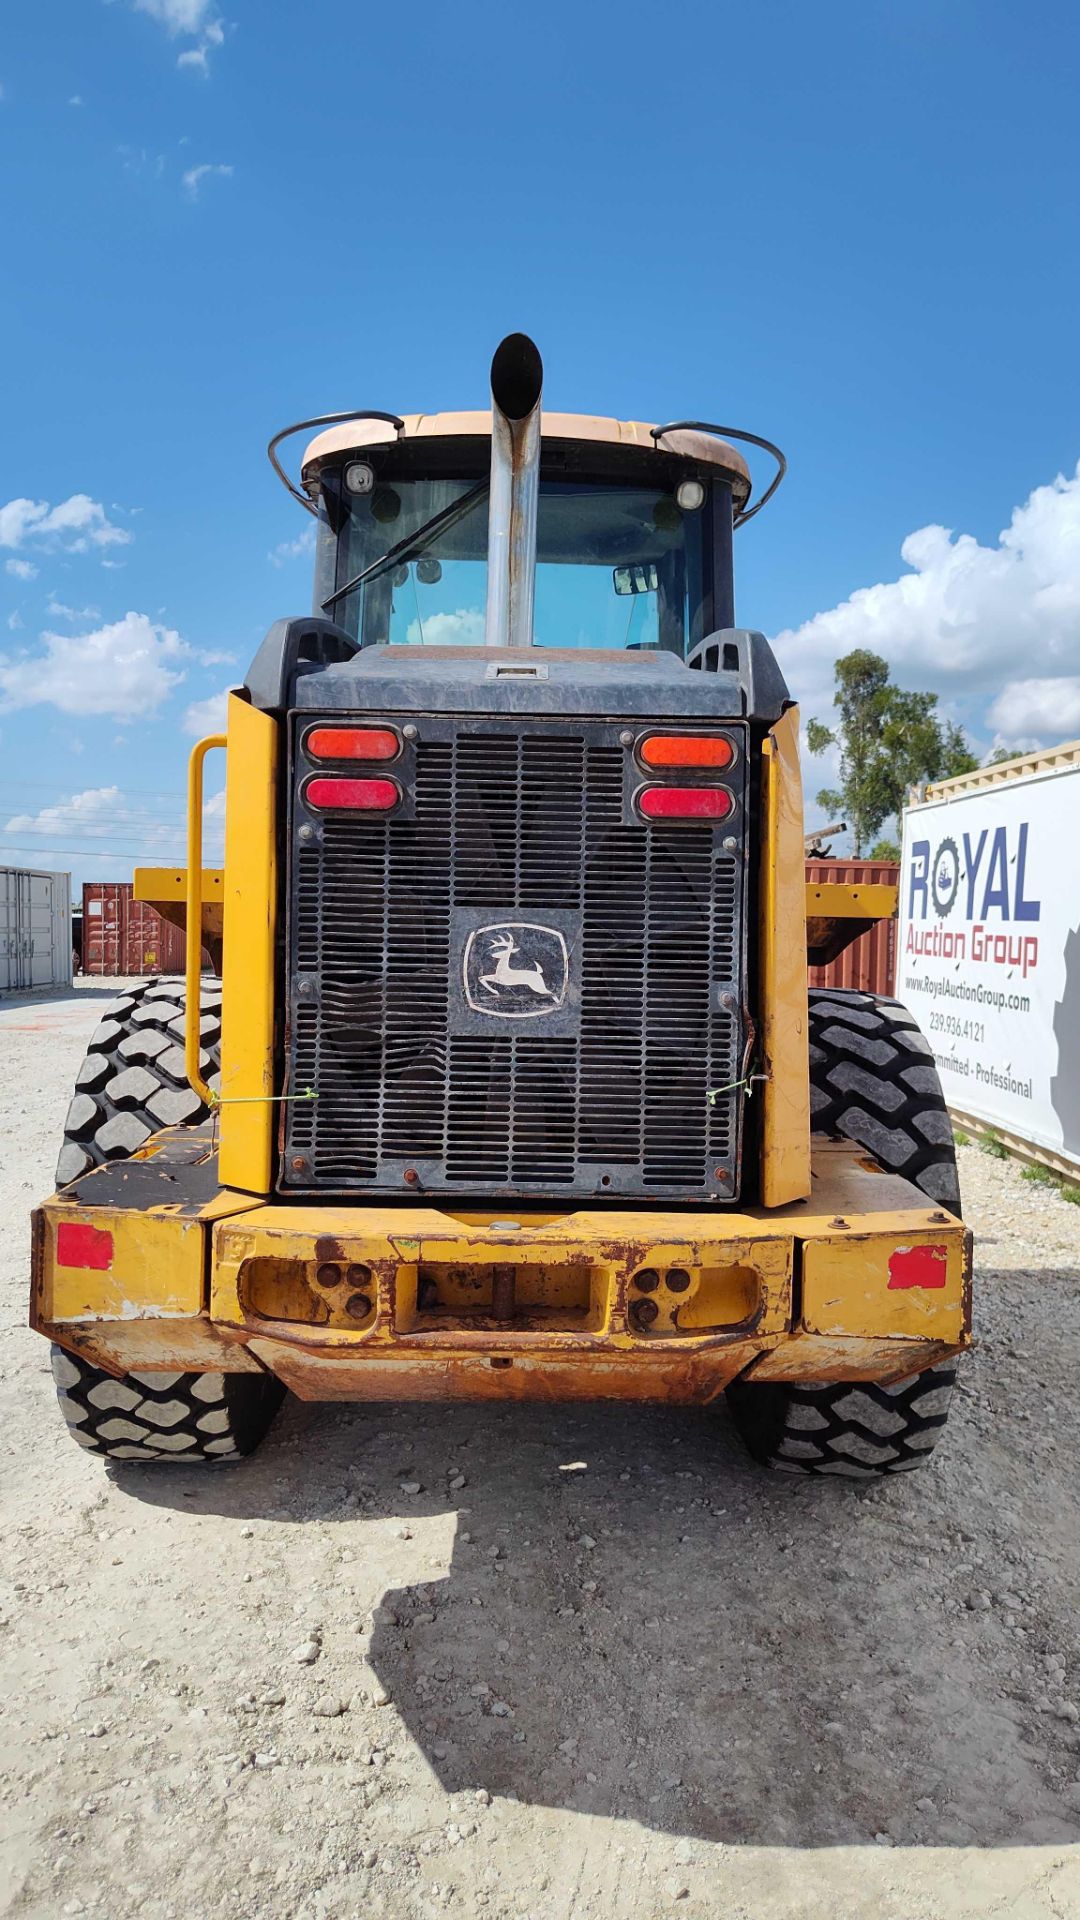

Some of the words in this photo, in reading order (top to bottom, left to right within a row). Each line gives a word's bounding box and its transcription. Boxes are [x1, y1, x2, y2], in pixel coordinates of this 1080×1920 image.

[908, 822, 1041, 921] ROYAL
[906, 922, 966, 960] Auction
[971, 925, 1038, 979] Group
[905, 976, 1031, 1013] www.RoyalAuctionGroup.com
[929, 1011, 985, 1042] 239.936.4121
[976, 1062, 1033, 1100] Professional
